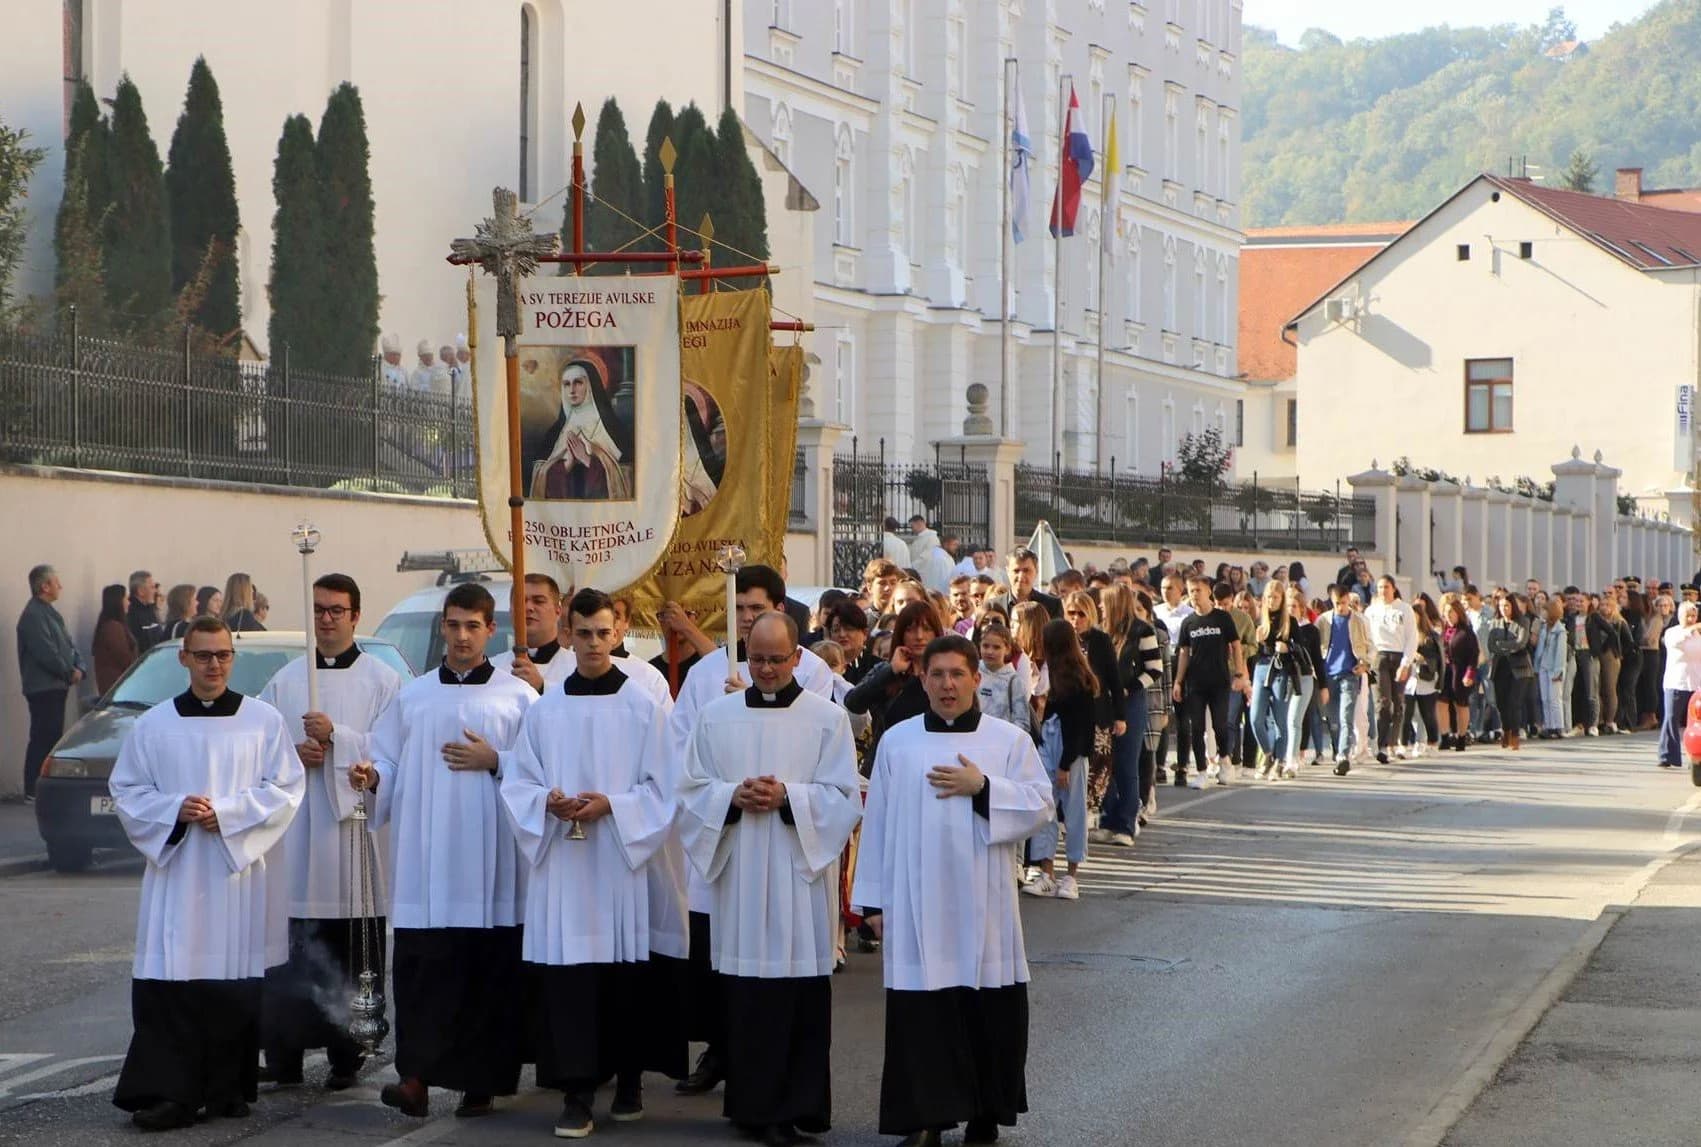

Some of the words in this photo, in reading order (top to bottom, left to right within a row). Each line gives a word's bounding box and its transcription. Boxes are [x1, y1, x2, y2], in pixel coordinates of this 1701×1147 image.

[548, 292, 603, 305] TEREZIJE
[606, 292, 656, 304] AVILSKE
[535, 307, 617, 328] POŽEGA
[686, 317, 741, 333] IMNAZIJA
[682, 336, 706, 349] EGI
[551, 520, 635, 538] OBLJETNICA
[570, 527, 655, 552] KATEDRALE
[673, 561, 695, 576] ZA
[699, 559, 725, 575] NA
[1190, 626, 1221, 638] adidas
